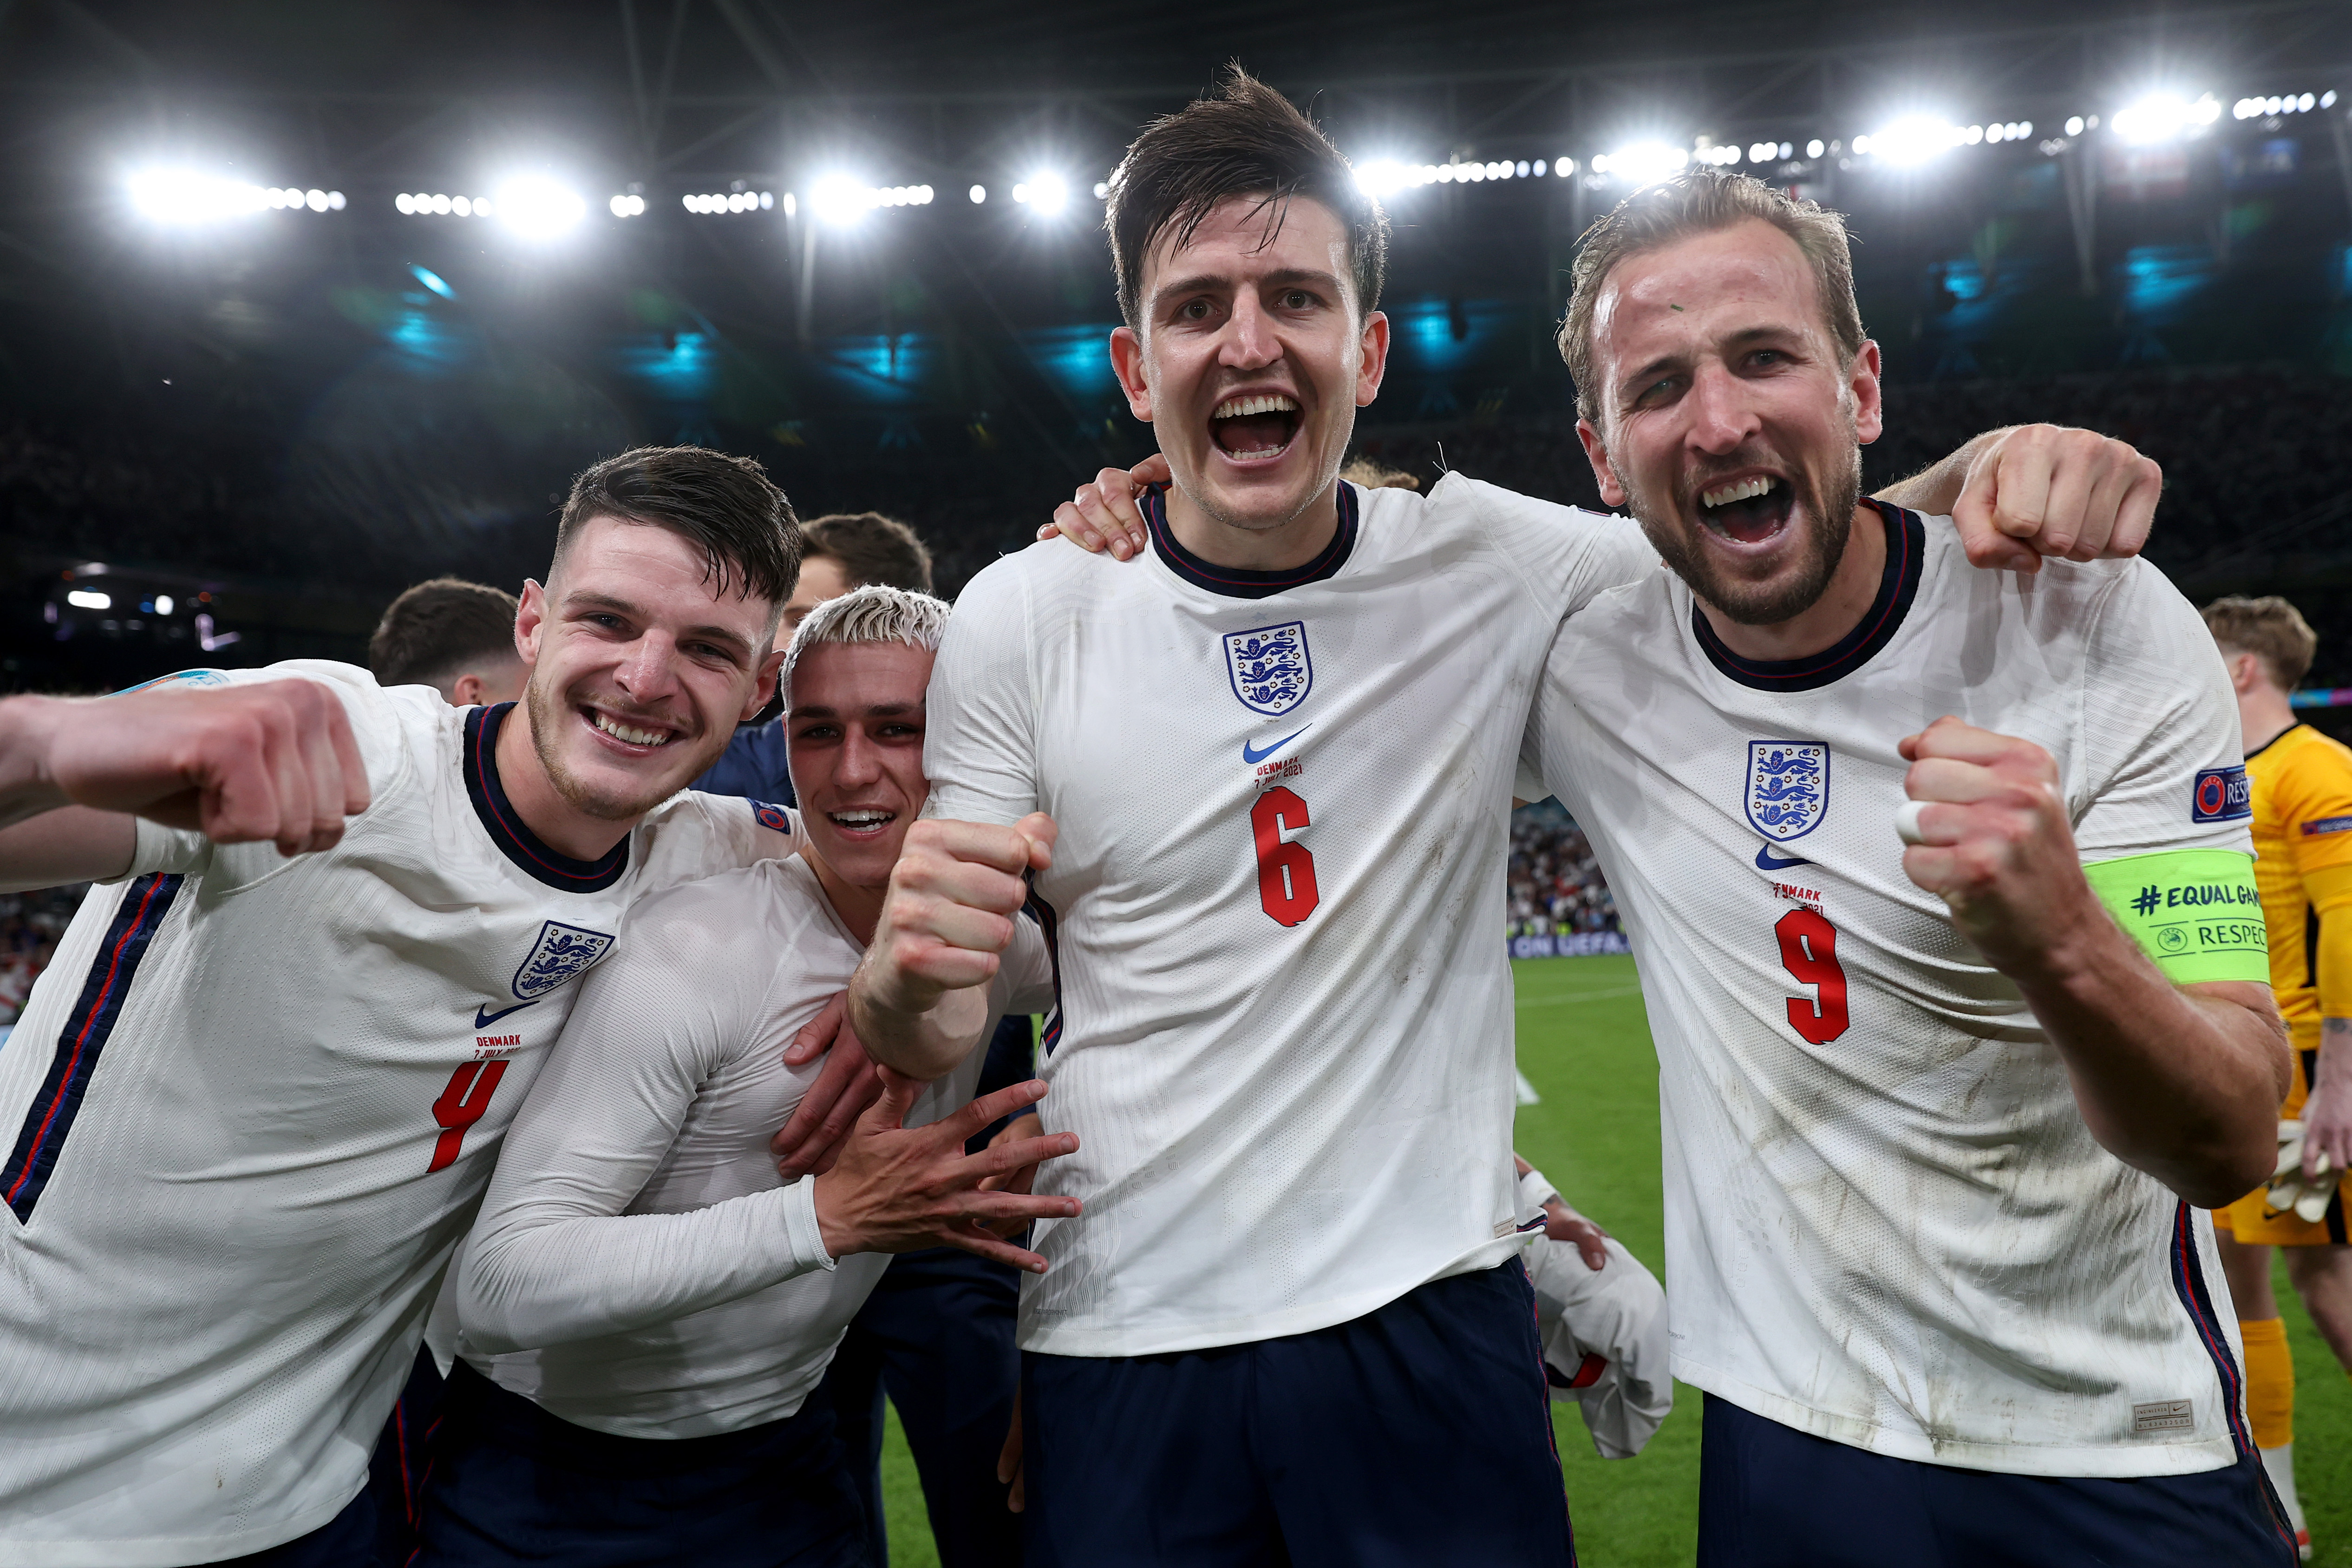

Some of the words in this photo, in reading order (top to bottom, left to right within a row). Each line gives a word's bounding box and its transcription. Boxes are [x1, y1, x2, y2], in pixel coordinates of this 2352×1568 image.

[1257, 755, 1300, 776] DENMARK
[1254, 779, 1260, 789] 7
[1284, 764, 1302, 777] 2021
[1250, 786, 1320, 928] 6
[1770, 881, 1821, 902] ENMARK
[2198, 925, 2266, 946] RESPEC
[1774, 906, 1850, 1045] 9
[476, 1034, 520, 1046] DENMARK
[474, 1050, 480, 1059] 7
[480, 1049, 503, 1059] JULY
[425, 1060, 510, 1174] 4
